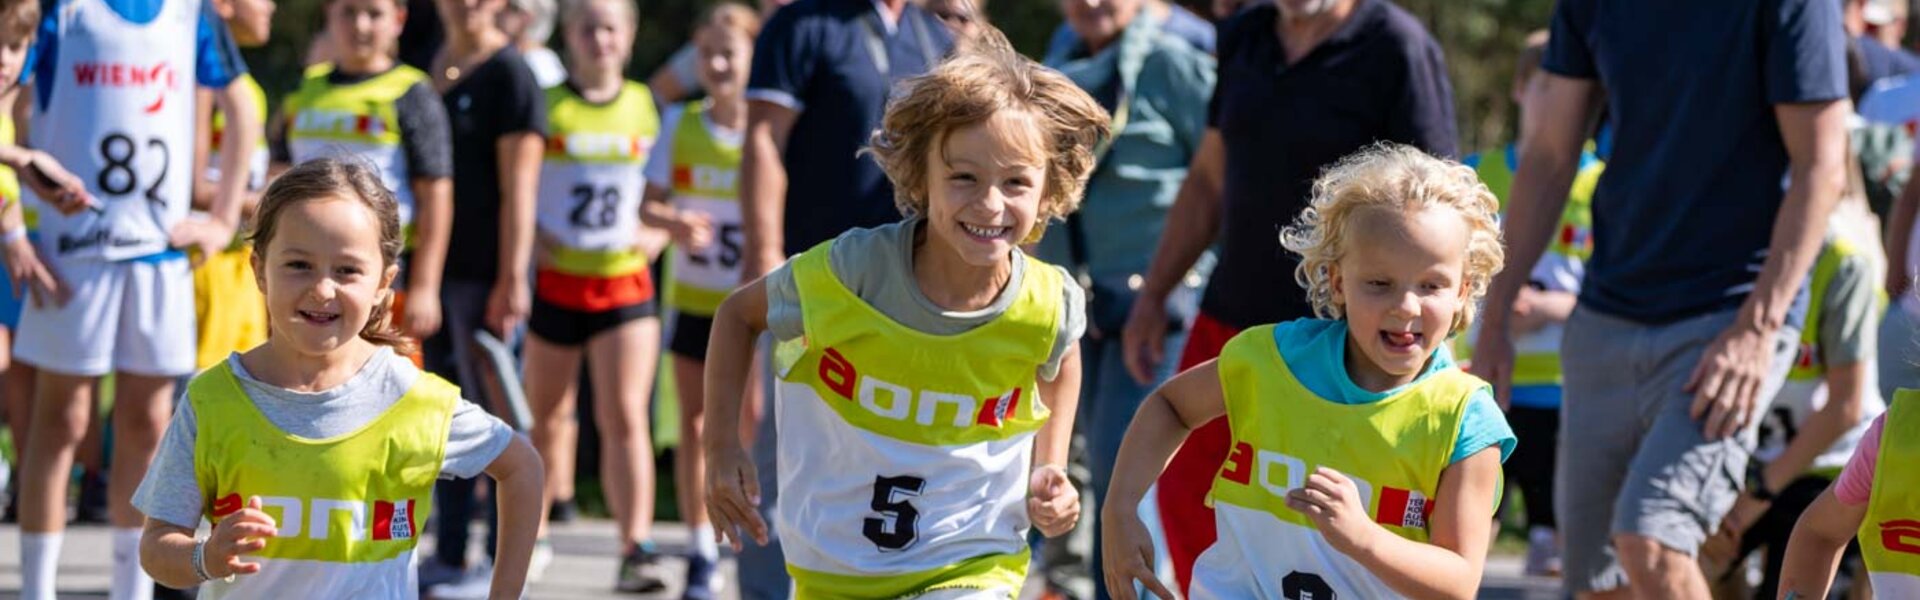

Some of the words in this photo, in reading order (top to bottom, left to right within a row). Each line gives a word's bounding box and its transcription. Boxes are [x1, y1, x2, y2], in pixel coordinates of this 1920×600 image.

[97, 132, 169, 209] 82
[567, 184, 621, 229] 28
[688, 223, 741, 269] 5
[818, 347, 976, 428] aon
[862, 474, 927, 553] 5
